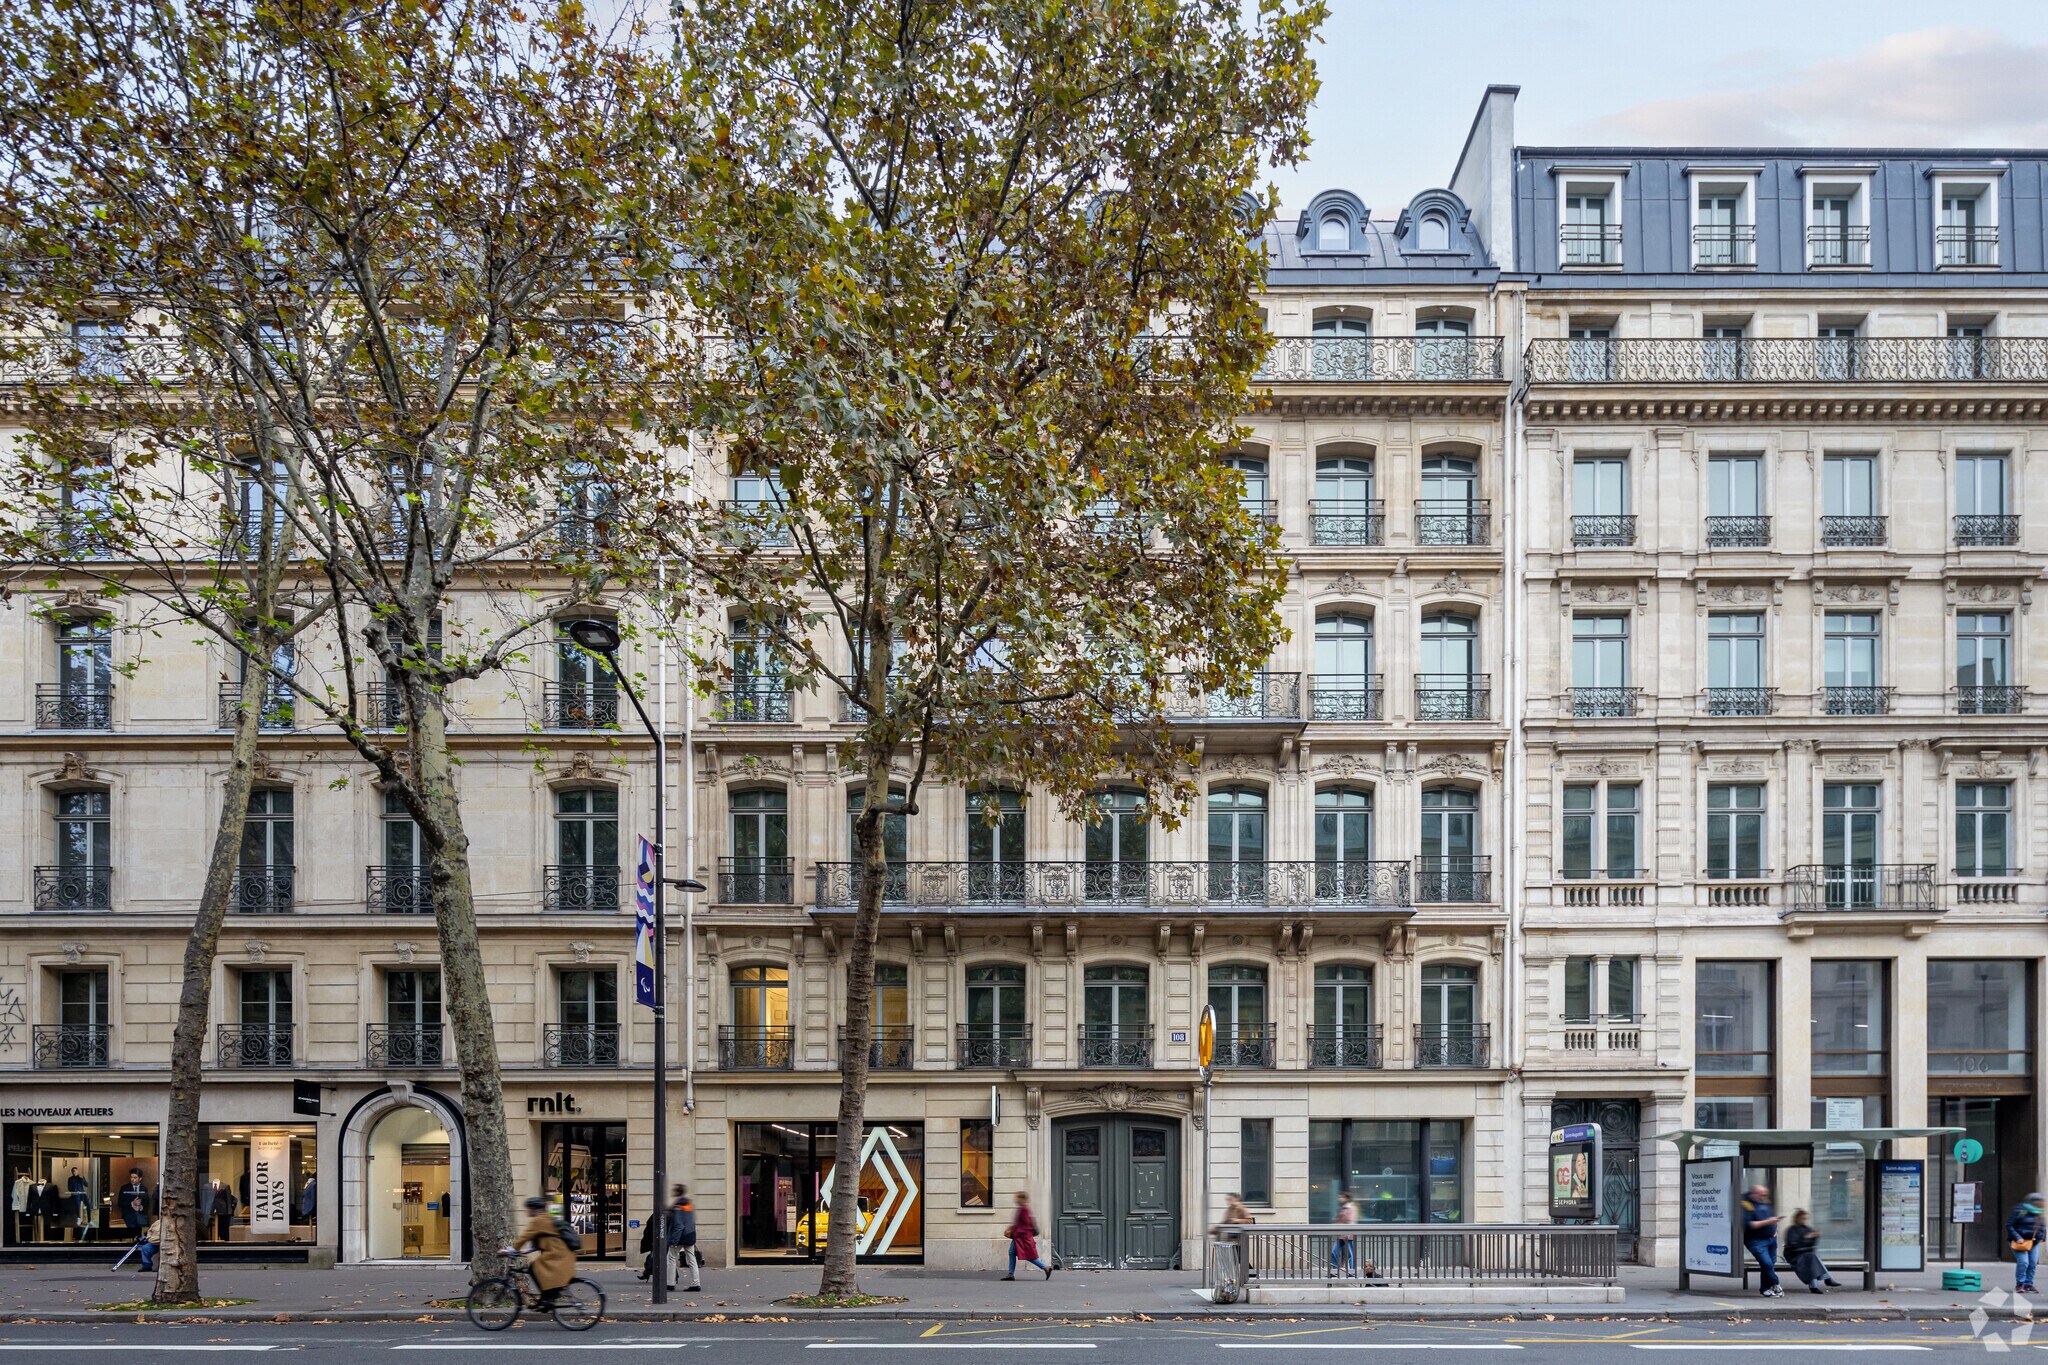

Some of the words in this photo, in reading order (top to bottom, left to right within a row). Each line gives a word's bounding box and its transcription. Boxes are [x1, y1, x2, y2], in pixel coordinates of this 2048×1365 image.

[1172, 1033, 1185, 1041] 108
[1953, 1055, 1989, 1072] 106
[527, 1092, 582, 1112] rnlt.
[0, 1108, 16, 1117] LES
[18, 1107, 72, 1117] NOUVEAUX
[74, 1107, 114, 1117] ATELIERS
[256, 1160, 269, 1222] TAILOR
[272, 1180, 285, 1221] DAYS
[1698, 1196, 1707, 1204] plus
[1691, 1211, 1712, 1220] joignable
